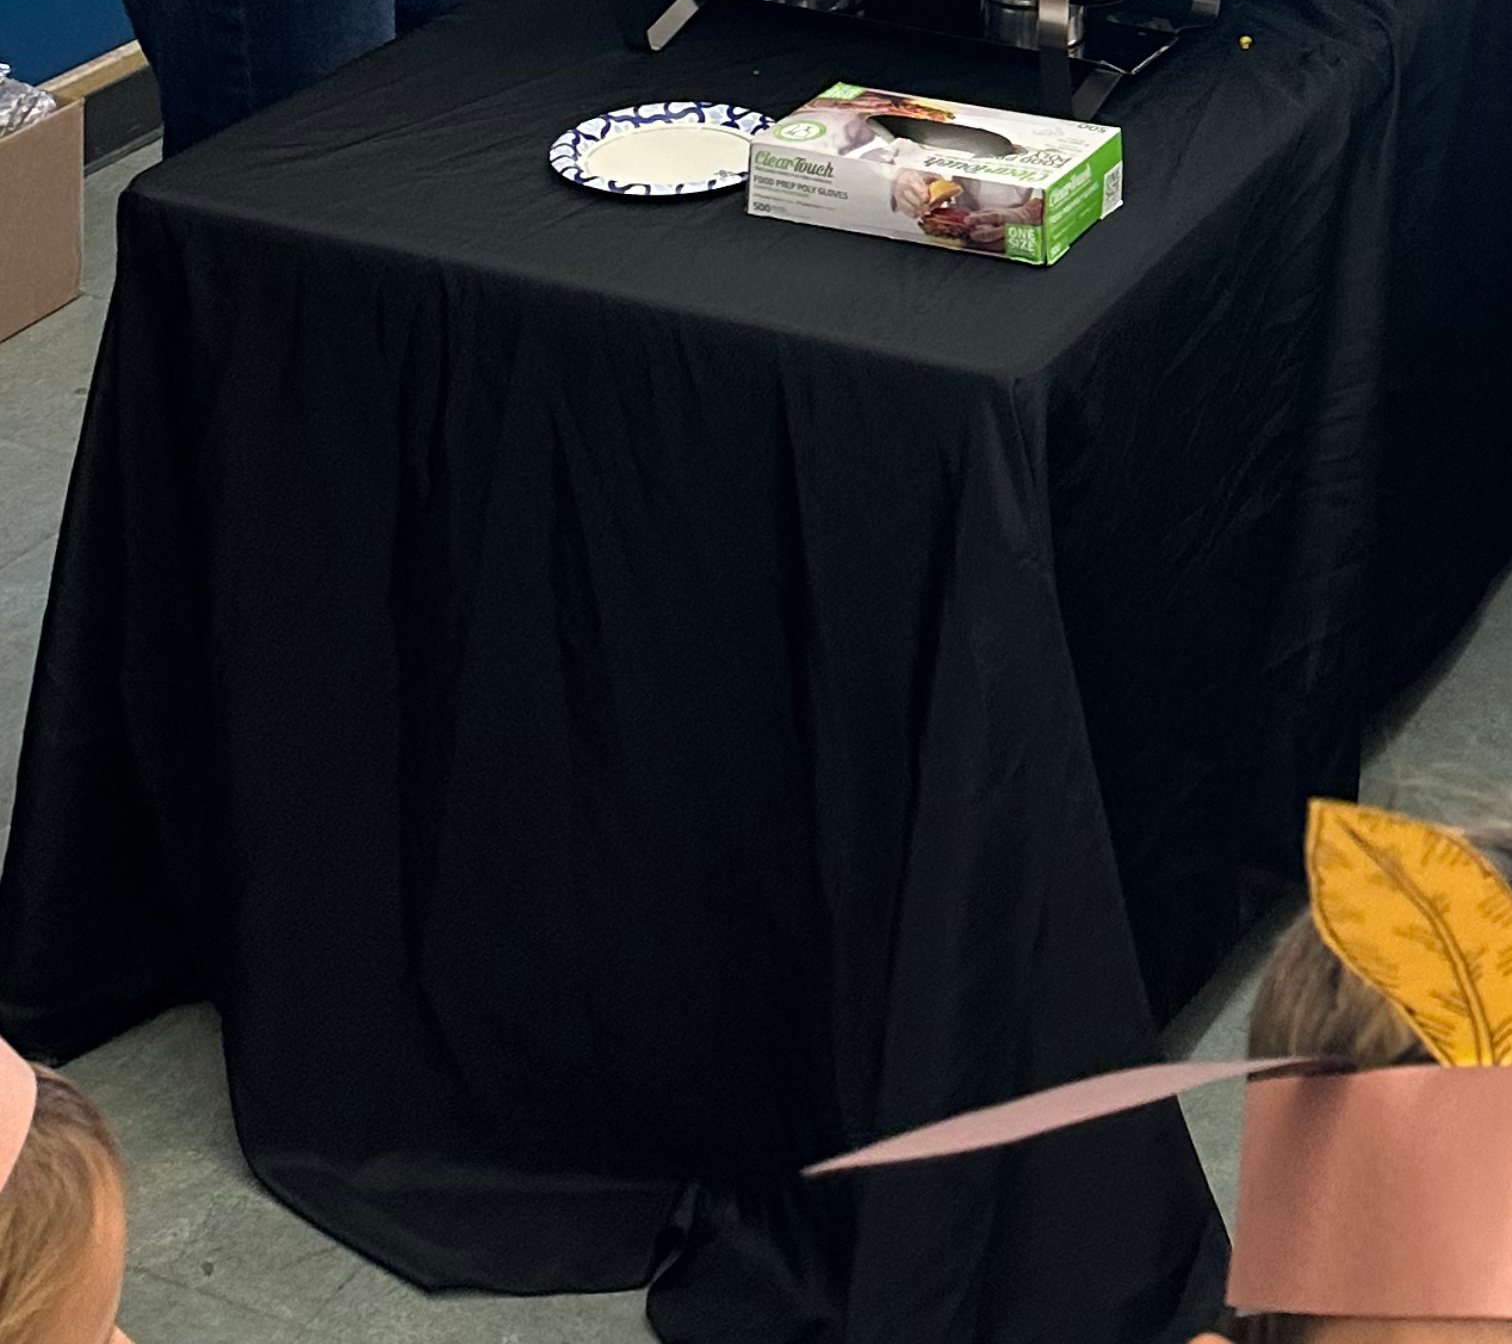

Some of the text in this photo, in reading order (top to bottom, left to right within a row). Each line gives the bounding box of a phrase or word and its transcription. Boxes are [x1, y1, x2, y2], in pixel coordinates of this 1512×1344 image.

[753, 175, 774, 185] FOOD
[818, 187, 848, 200] GLOVES
[1008, 226, 1035, 240] ONE
[1008, 238, 1036, 252] SIZE
